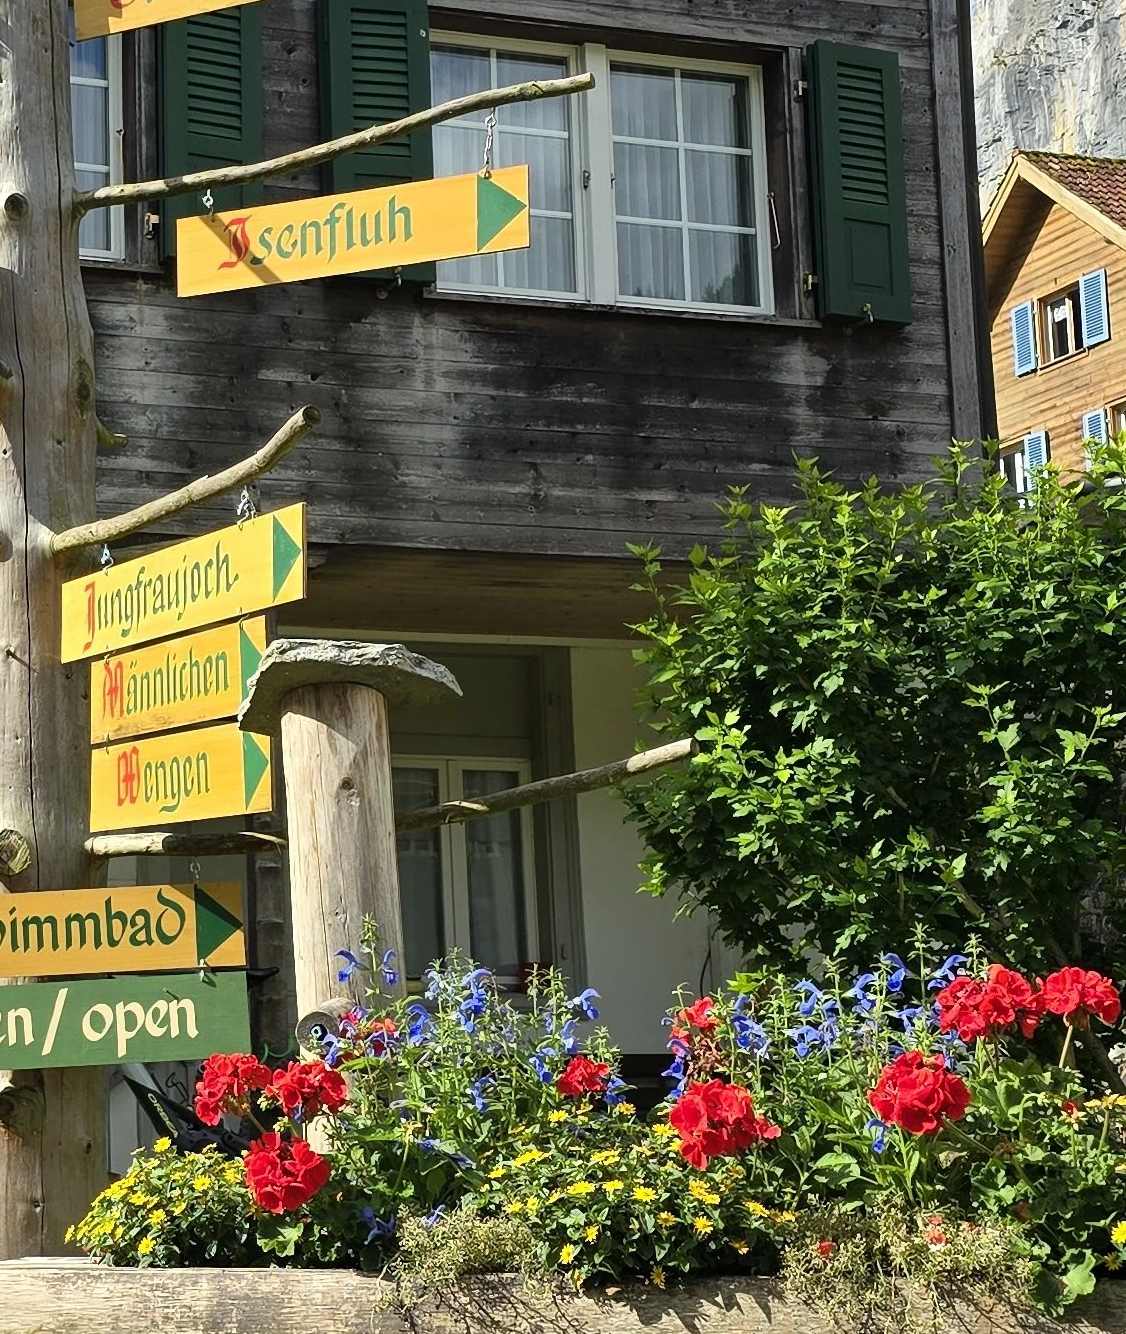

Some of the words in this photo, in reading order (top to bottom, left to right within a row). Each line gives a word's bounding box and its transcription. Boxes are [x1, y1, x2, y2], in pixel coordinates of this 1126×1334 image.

[217, 195, 414, 271] Isenfluh
[83, 541, 239, 653] Jungfraujoch
[102, 645, 230, 719] Männlichen
[117, 745, 210, 814] Wengen
[82, 997, 199, 1058] open
